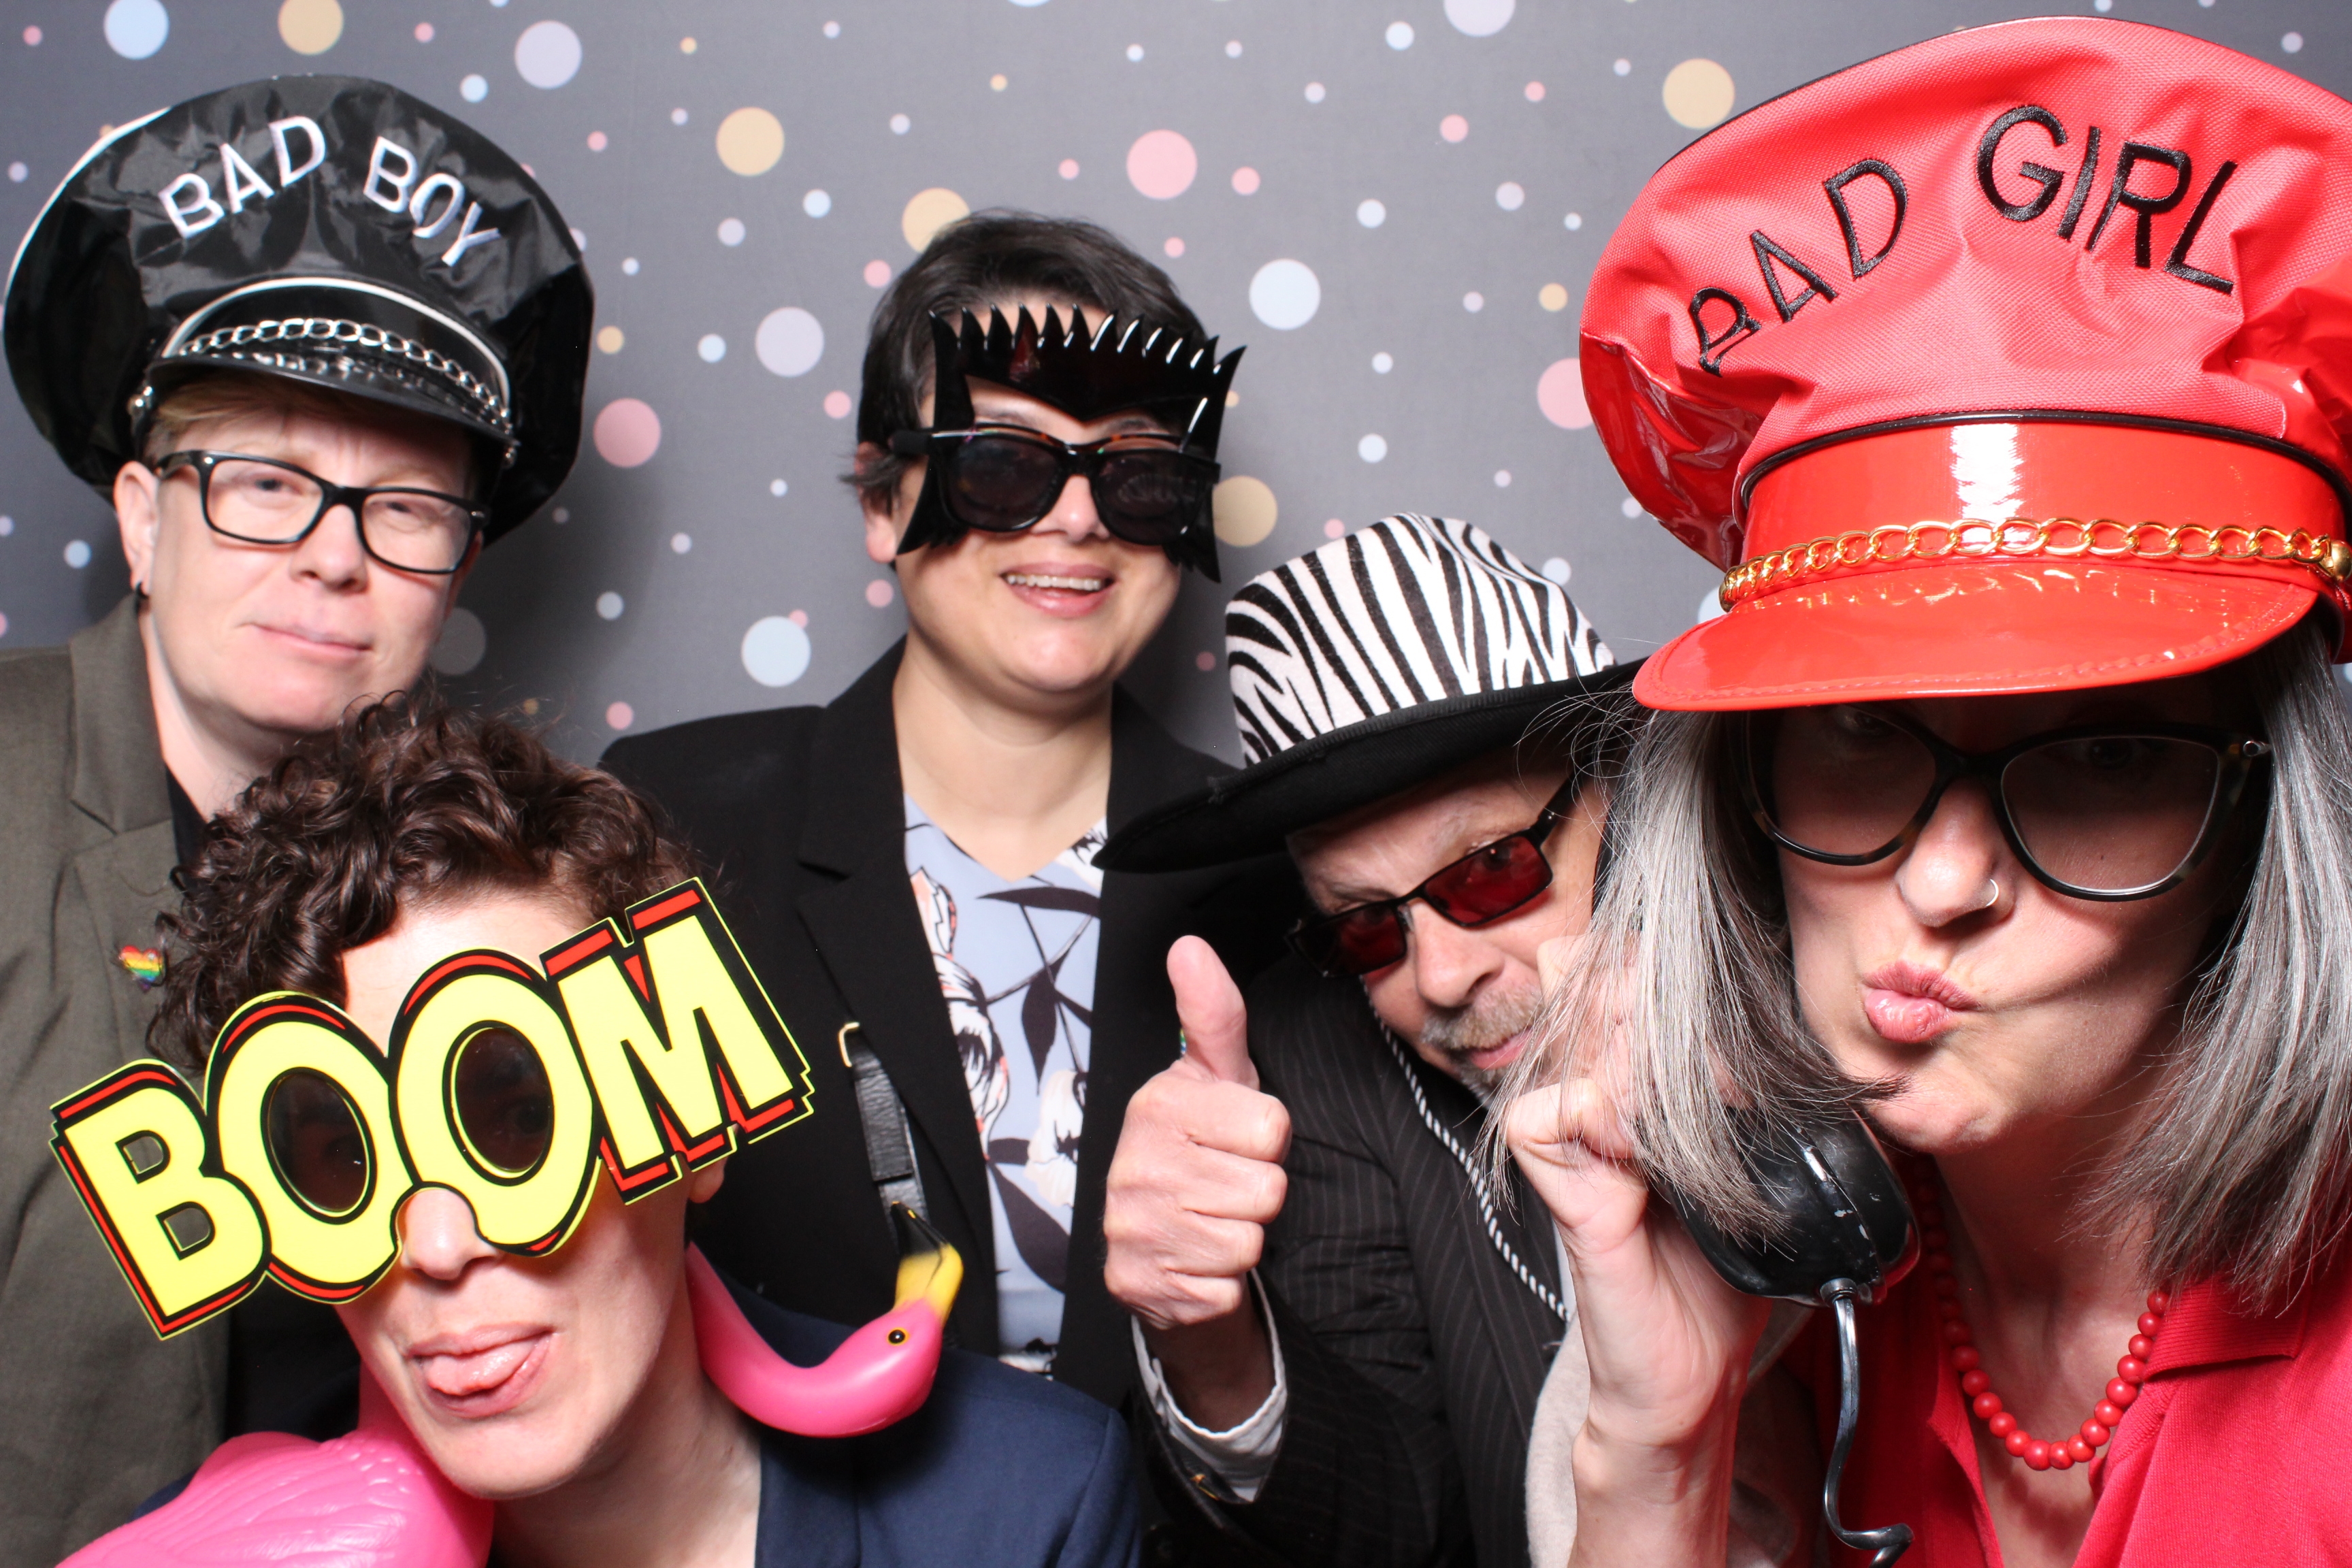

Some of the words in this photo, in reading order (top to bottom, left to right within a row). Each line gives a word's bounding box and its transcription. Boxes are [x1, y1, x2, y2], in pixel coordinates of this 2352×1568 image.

[157, 115, 326, 240] BAD
[362, 135, 502, 267] BOY
[1687, 158, 1909, 378] BAD
[1976, 103, 2239, 296] GIRL
[52, 881, 811, 1337] BOOM
